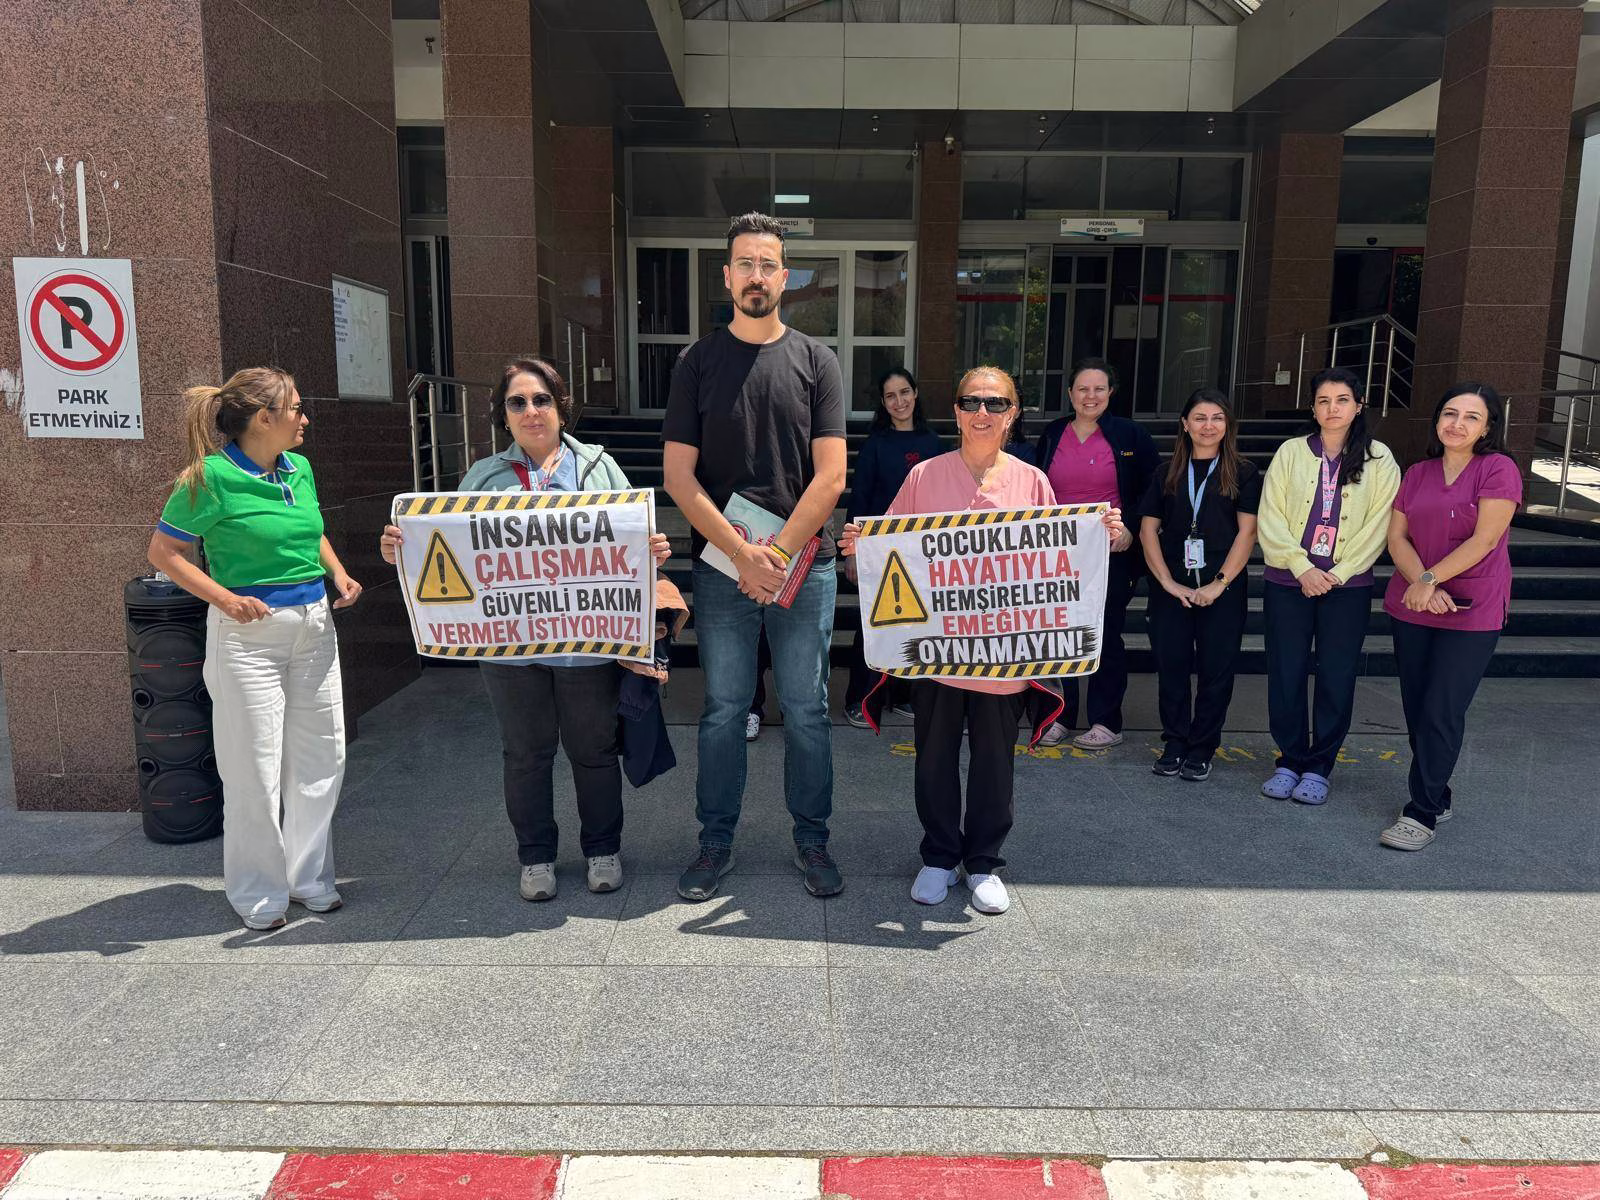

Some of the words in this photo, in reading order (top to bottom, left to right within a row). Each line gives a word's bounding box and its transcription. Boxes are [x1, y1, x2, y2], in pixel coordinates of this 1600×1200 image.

[57, 388, 109, 405] PARK
[29, 410, 131, 429] ETMEYİNİZ
[469, 510, 615, 551] İNSANCA
[921, 520, 1078, 563] ÇOCUKLARIN
[475, 544, 638, 590] ÇALIŞMAK,
[928, 549, 1080, 587] HAYATIYLA,
[482, 587, 570, 617] GÜVENLİ
[577, 588, 641, 613] BAKIM
[931, 579, 1080, 614] HEMŞİRELERİN
[428, 619, 522, 645] VERMEK
[527, 613, 641, 643] İSTİYORUZ!
[942, 606, 1068, 636] EMEĞİYLE
[918, 630, 1083, 664] OYNAMAYIN!
